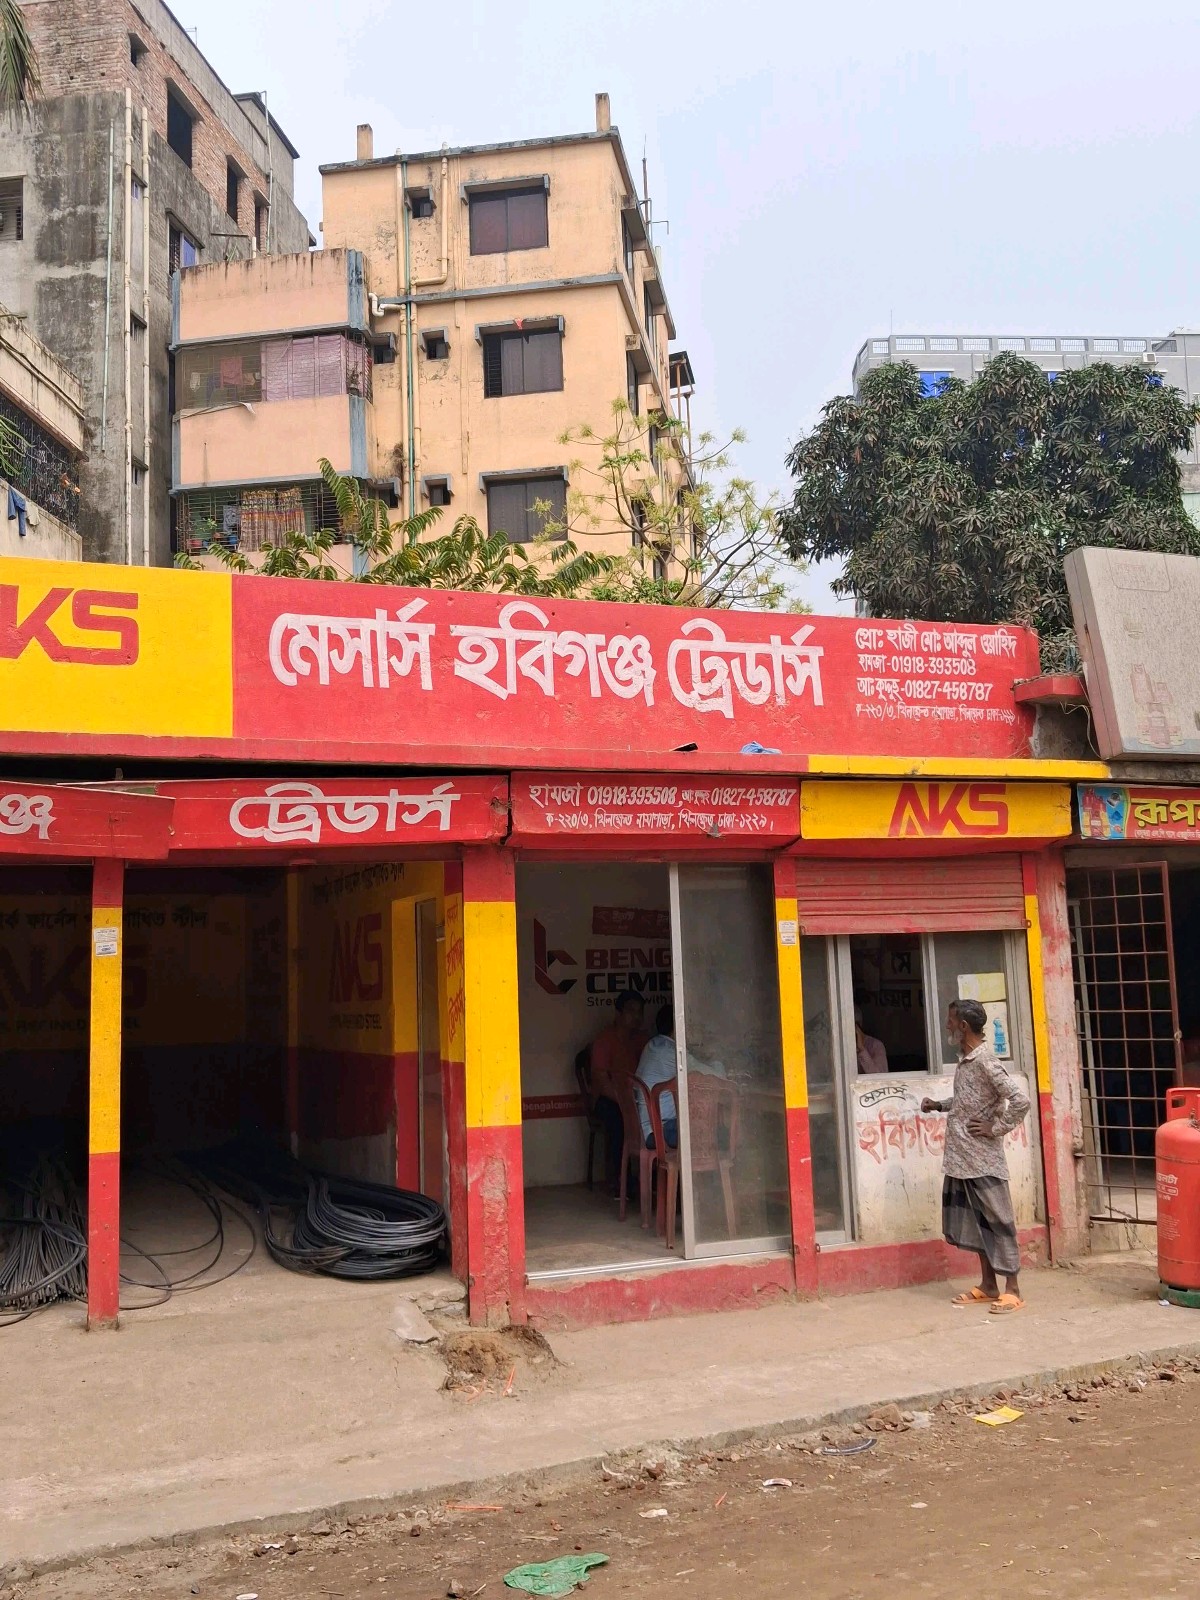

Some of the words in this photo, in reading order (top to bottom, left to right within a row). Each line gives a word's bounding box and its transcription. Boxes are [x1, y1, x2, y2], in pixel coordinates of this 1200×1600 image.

[0, 584, 139, 665] KS
[886, 623, 919, 652] হাজী
[269, 597, 436, 690] মেসার্স
[450, 601, 657, 707] হবিগঞ্জ
[667, 617, 824, 719] ট্রেডার্স
[529, 782, 584, 808] হামজা
[711, 786, 797, 806] 01827-458787
[888, 782, 1009, 837] AKS
[229, 782, 461, 842] ট্রেডার্স
[1131, 798, 1200, 828] রূপ
[585, 947, 672, 969] BENG
[586, 971, 673, 994] CEME
